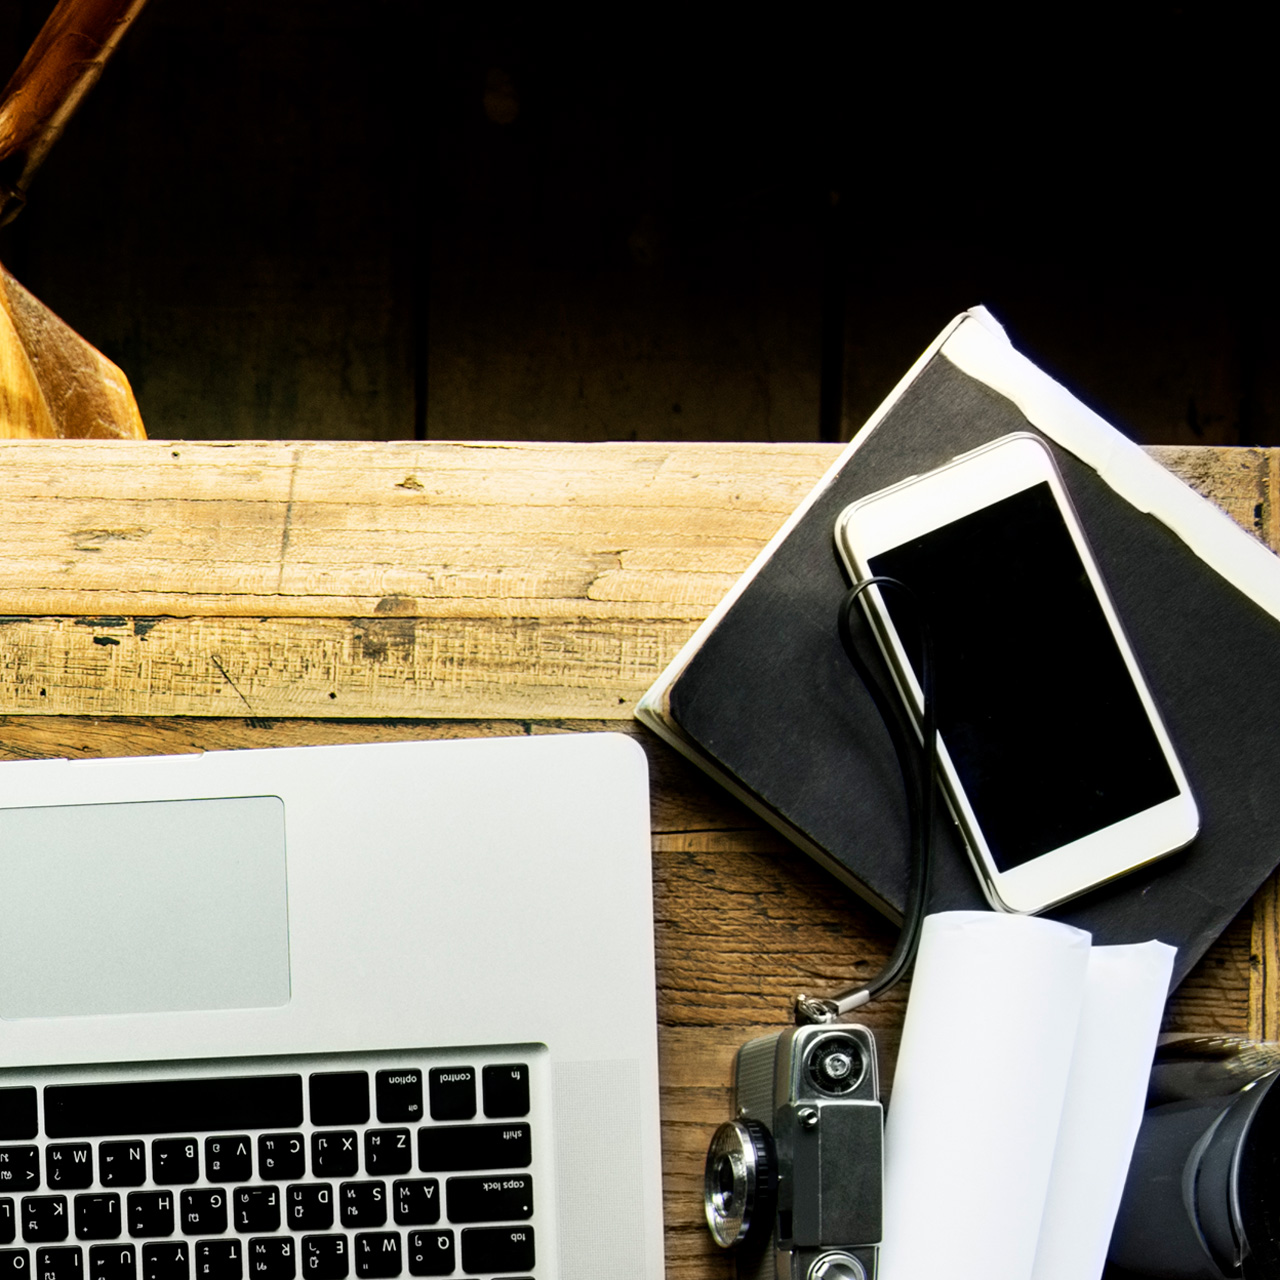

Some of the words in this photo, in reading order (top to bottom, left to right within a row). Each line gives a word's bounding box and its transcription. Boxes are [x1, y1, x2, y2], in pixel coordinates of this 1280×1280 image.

[388, 1074, 418, 1085] option
[439, 1072, 471, 1084] control
[511, 1070, 521, 1081] fn
[502, 1130, 522, 1140] shift
[482, 1182, 502, 1192] lock
[502, 1179, 525, 1189] caps
[510, 1233, 526, 1243] tab
